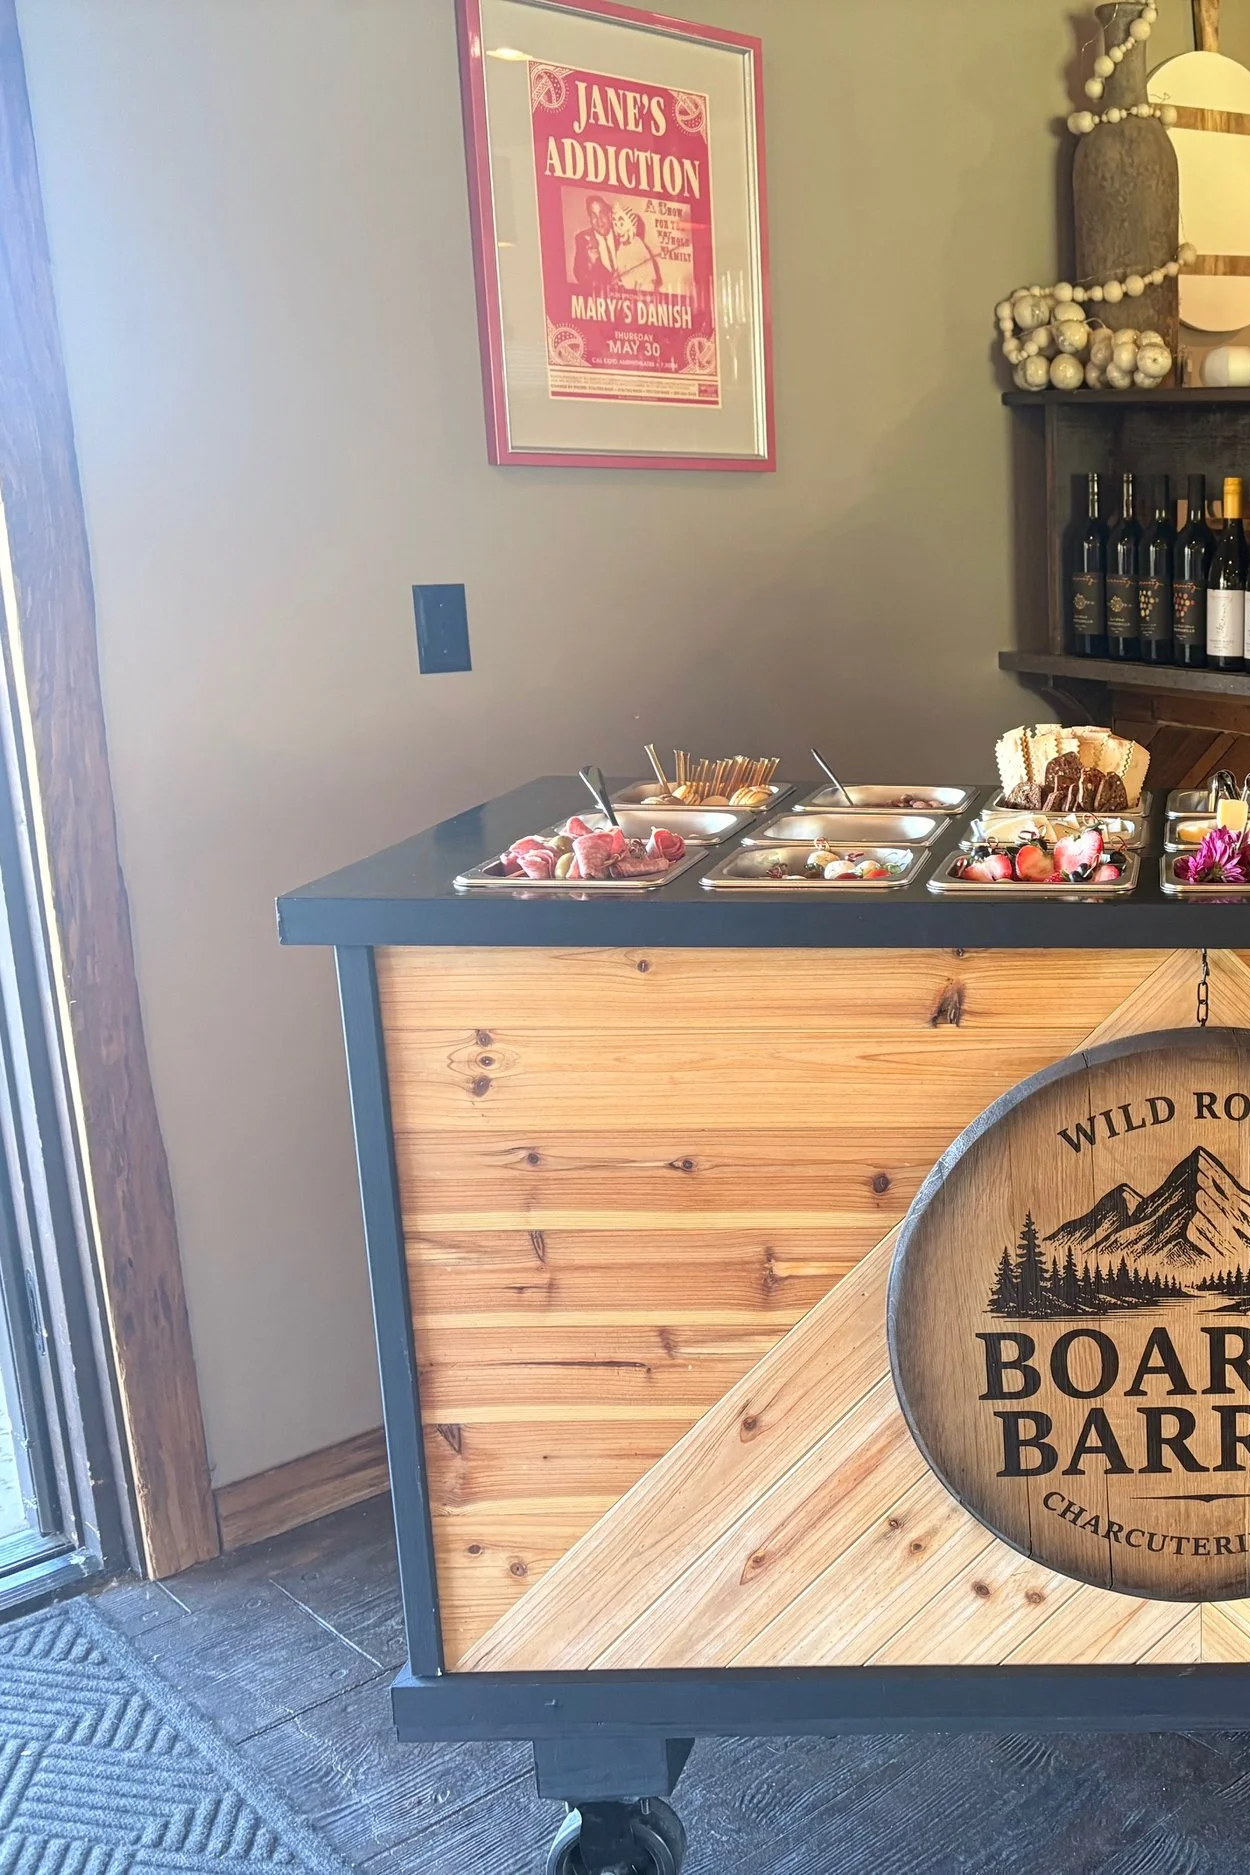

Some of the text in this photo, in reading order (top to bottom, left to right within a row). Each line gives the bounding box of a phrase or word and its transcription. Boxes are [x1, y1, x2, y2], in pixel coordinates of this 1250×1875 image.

[573, 81, 666, 136] JANE'S
[545, 136, 700, 199] ADDICTION
[571, 295, 692, 329] MARY'S DANISH
[608, 340, 660, 356] MAY 30
[614, 331, 653, 341] THURSDAY
[1057, 1095, 1176, 1154] WILD
